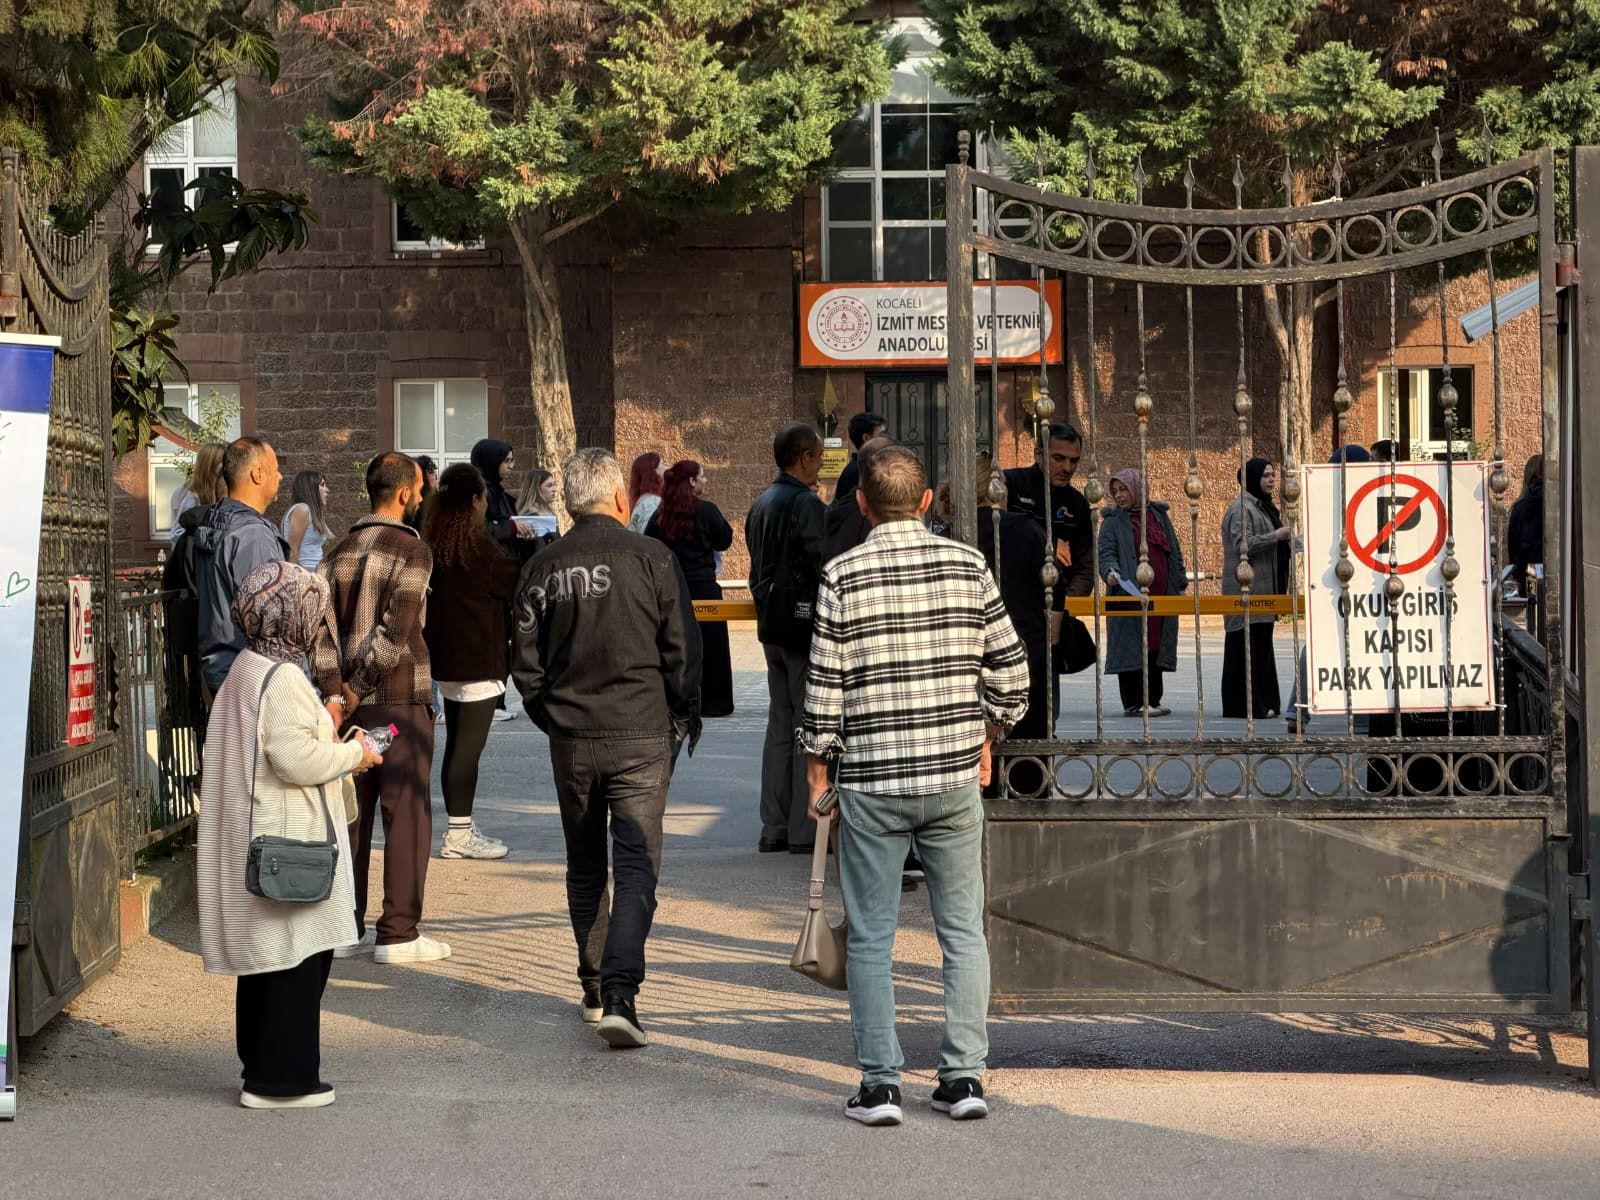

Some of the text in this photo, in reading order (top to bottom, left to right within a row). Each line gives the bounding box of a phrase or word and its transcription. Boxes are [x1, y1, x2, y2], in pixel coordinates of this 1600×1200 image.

[876, 295, 922, 309] KOCAELİ
[877, 312, 914, 331] İZMİT
[977, 314, 993, 329] VE
[877, 336, 945, 352] ANADOLU
[1233, 599, 1276, 608] PKOTEK
[1364, 628, 1433, 654] KAPISI
[1318, 663, 1483, 691] PARK YAPILMAZ
